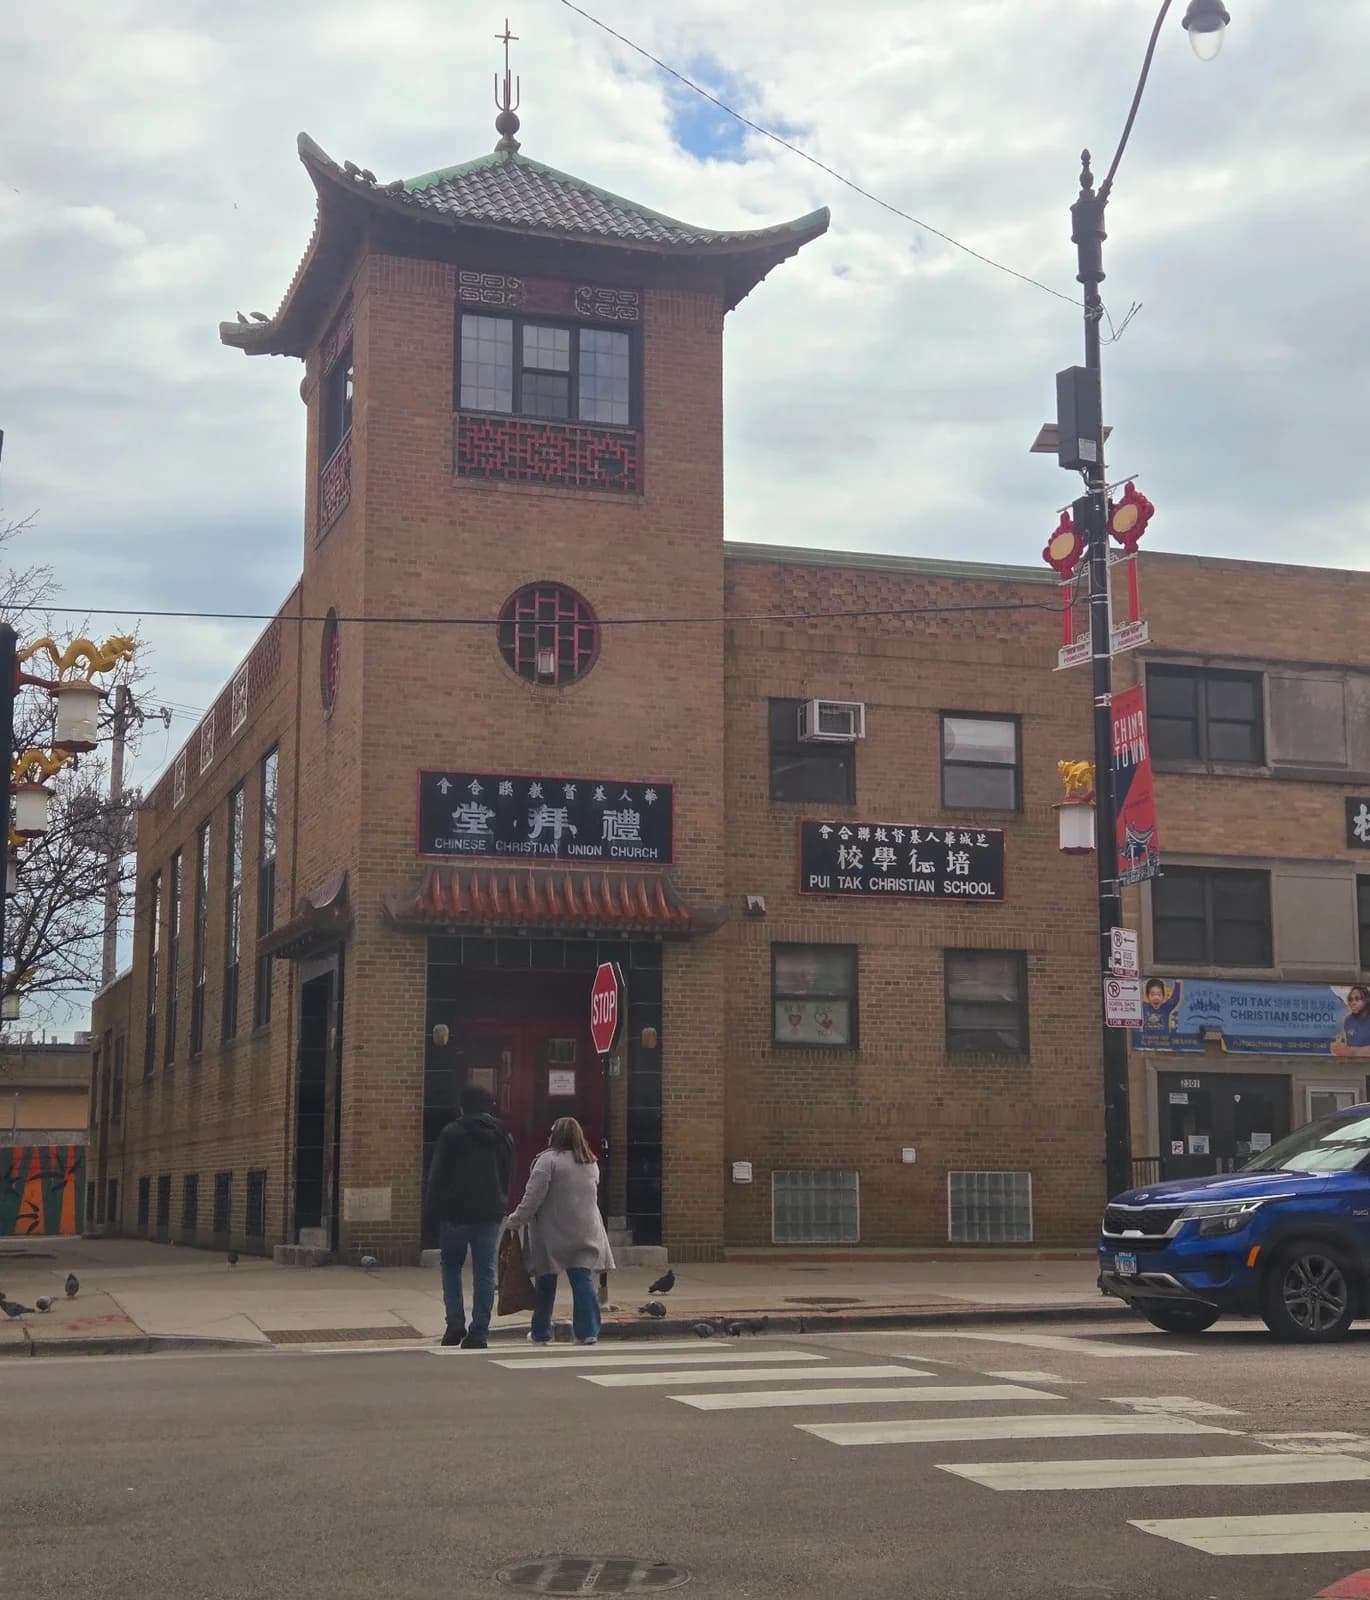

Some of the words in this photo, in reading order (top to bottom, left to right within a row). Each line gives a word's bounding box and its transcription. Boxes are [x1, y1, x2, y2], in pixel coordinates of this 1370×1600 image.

[1114, 710, 1144, 745] CHINA
[1114, 736, 1146, 770] TOWN
[434, 837, 486, 850] CHINESE
[495, 840, 559, 855] CHRISTIAN
[567, 844, 603, 856] UNION
[610, 846, 658, 858] CHURCH
[809, 875, 830, 888] PUI
[837, 875, 863, 890] TAK
[869, 877, 935, 893] CHRISTIAN
[943, 880, 996, 895] SCHOOL
[593, 991, 615, 1025] STOP
[1230, 996, 1248, 1007] PUI
[1250, 997, 1272, 1008] TAK
[1230, 1009, 1289, 1021] CHRISTIAN
[1291, 1011, 1337, 1023] SCHOOL
